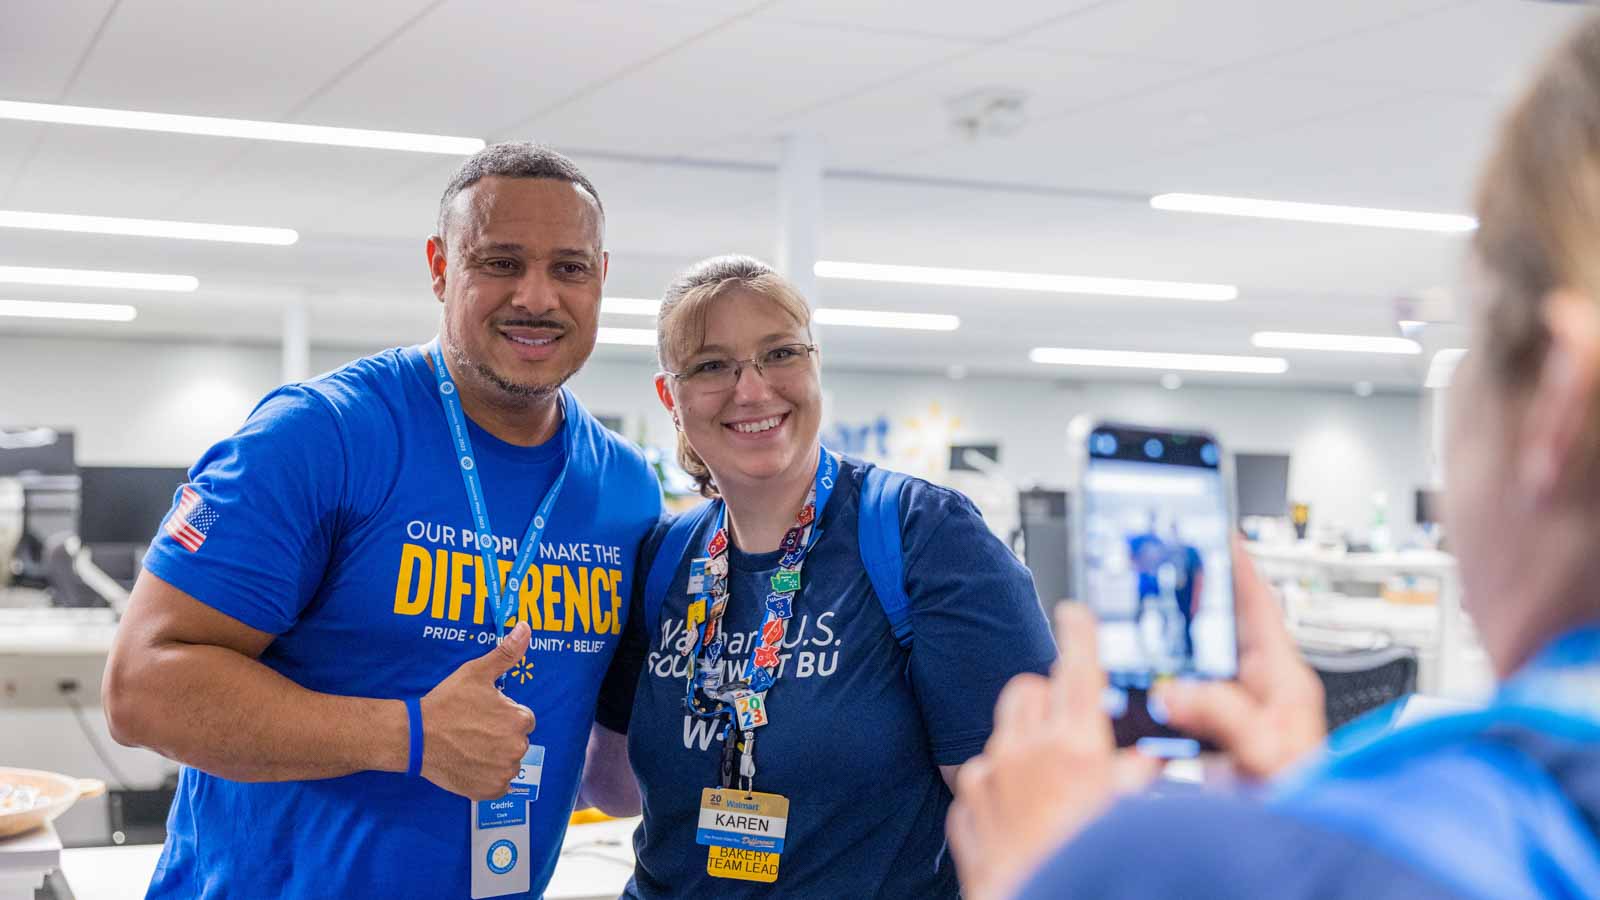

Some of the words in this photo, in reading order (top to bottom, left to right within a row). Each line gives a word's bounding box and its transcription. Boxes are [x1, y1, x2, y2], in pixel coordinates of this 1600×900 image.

[406, 520, 456, 546] OUR
[539, 541, 591, 563] MAKE
[595, 544, 622, 566] THE
[423, 626, 468, 642] PRIDE
[477, 631, 564, 652] OPUNITY
[782, 611, 841, 649] U.S.
[796, 650, 839, 679] BU
[490, 800, 514, 810] Cedric
[710, 794, 722, 803] 20
[726, 799, 759, 811] Walmart
[715, 813, 769, 832] KAREN
[720, 847, 771, 862] BAKERY
[709, 857, 742, 871] TEAM
[745, 861, 778, 875] LEAD
